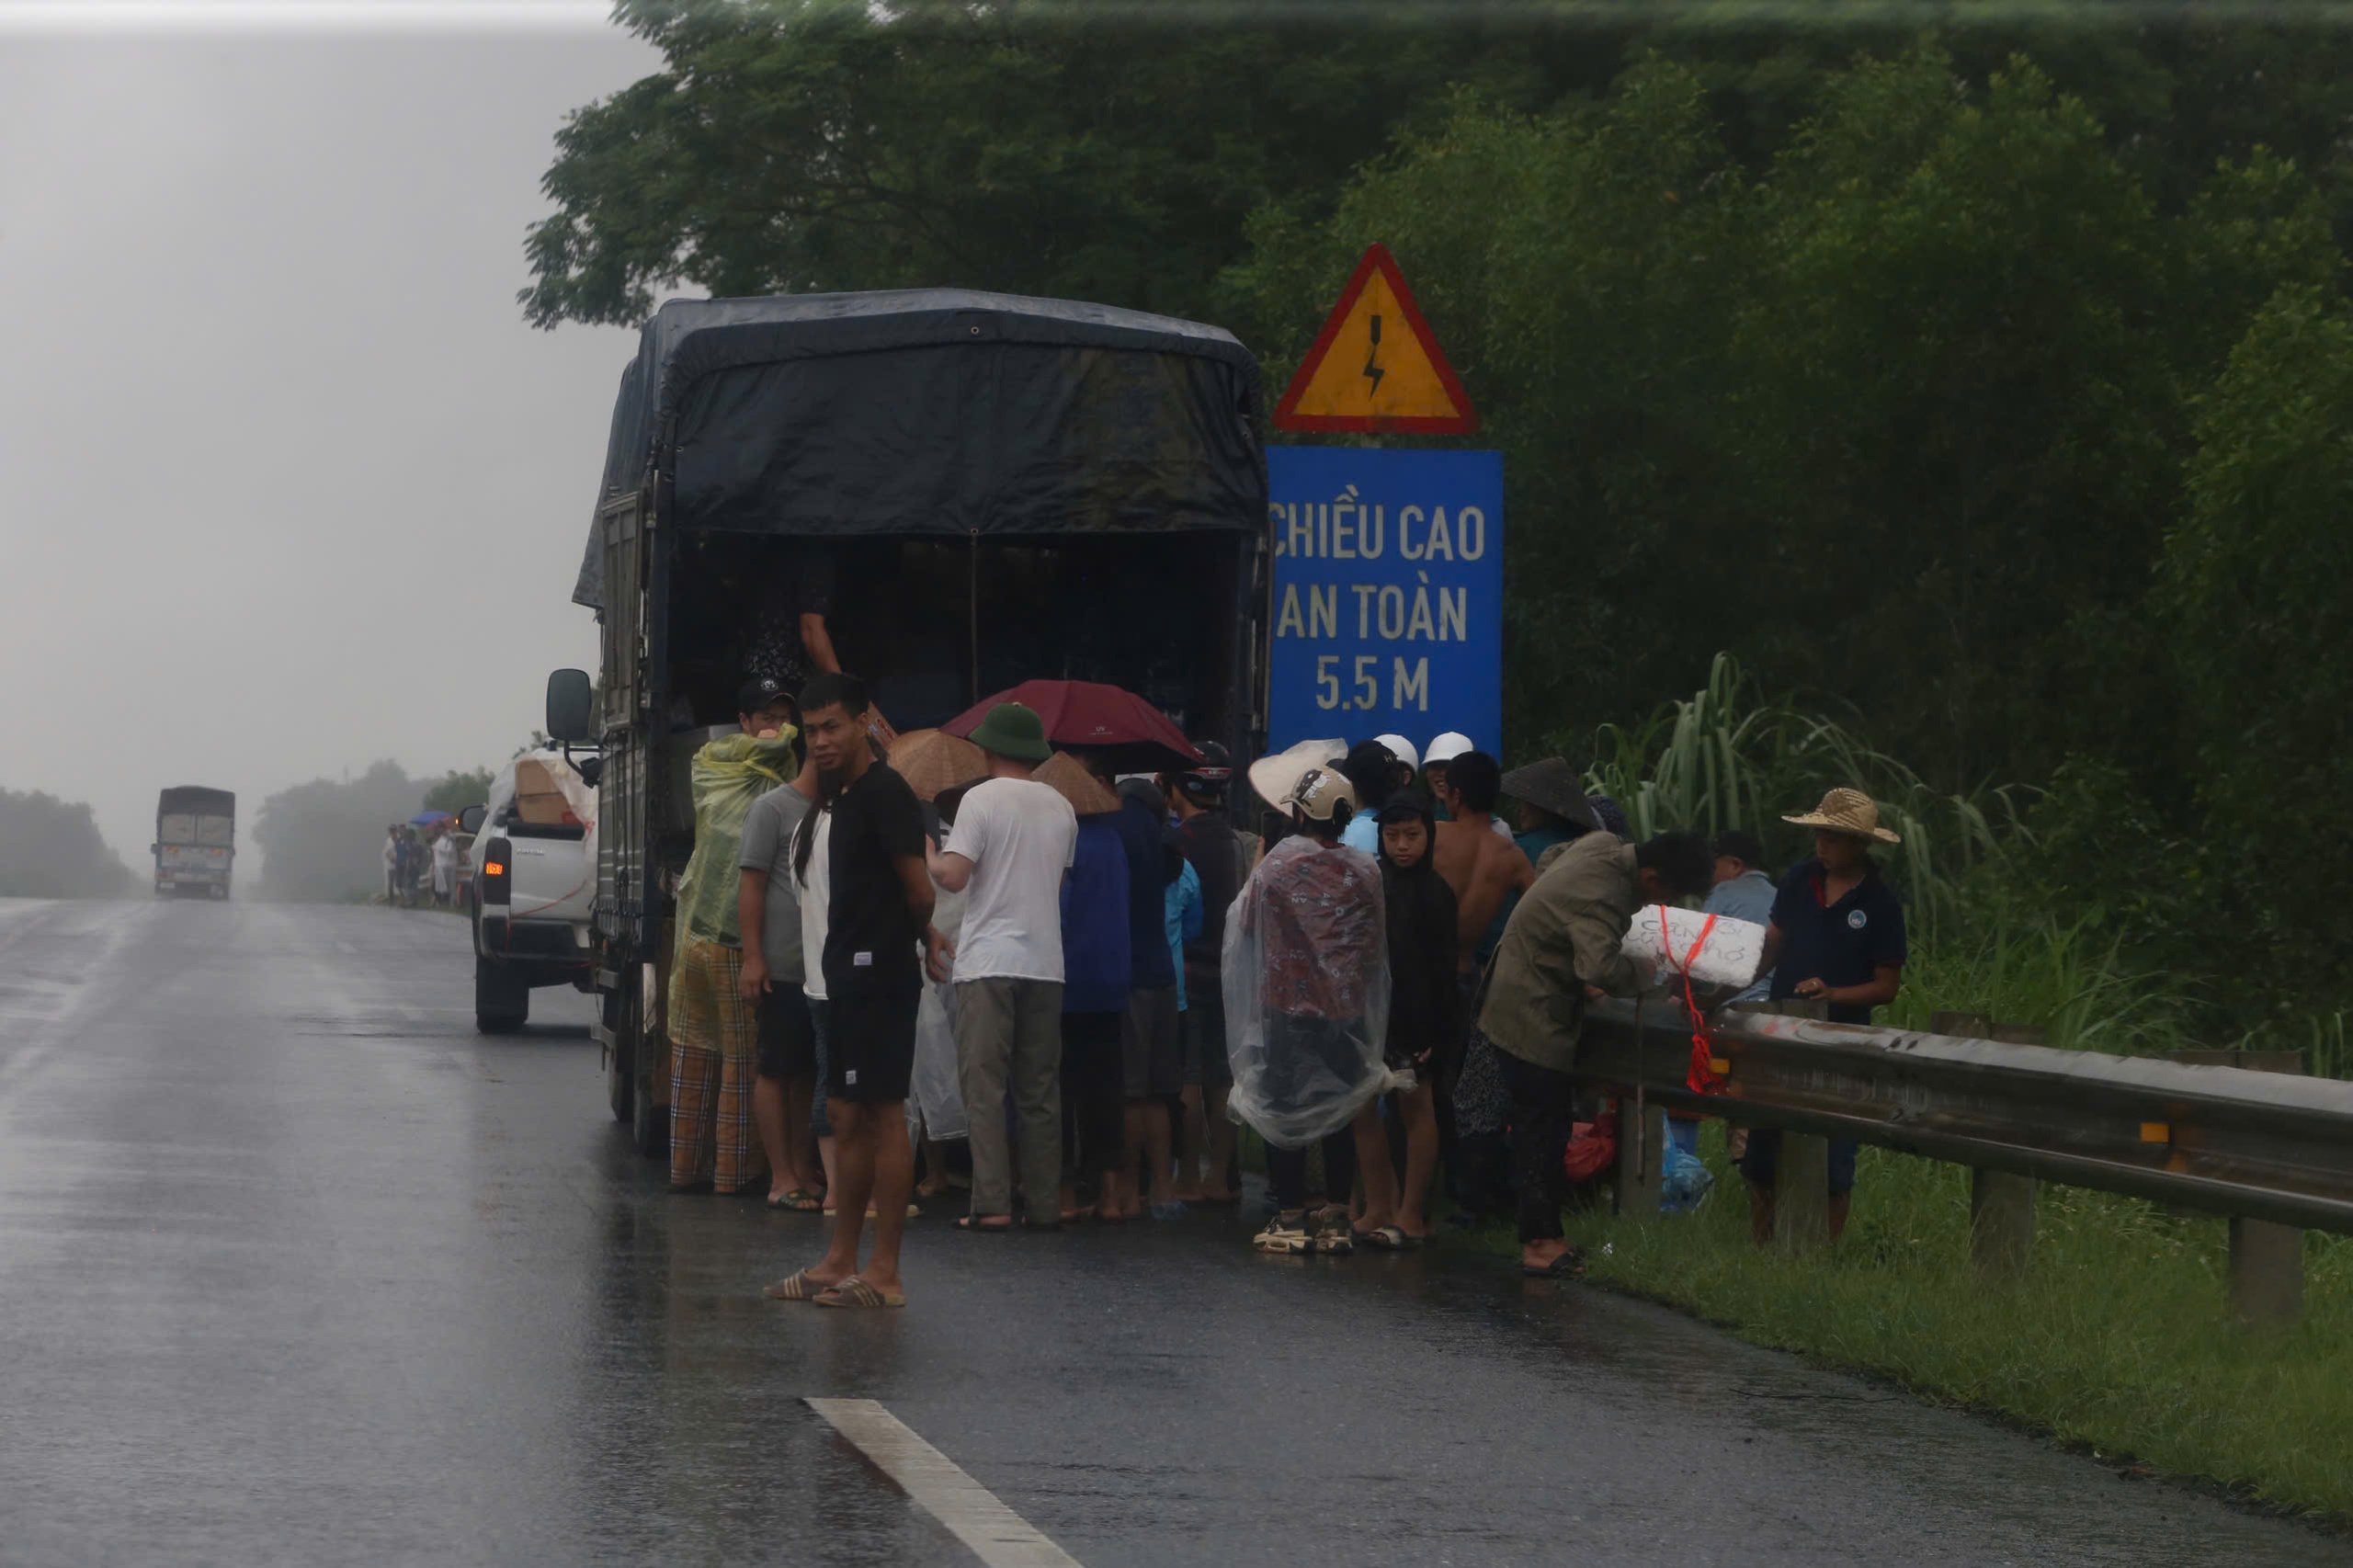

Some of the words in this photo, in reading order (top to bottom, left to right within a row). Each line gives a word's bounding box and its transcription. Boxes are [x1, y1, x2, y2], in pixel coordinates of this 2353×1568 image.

[1400, 504, 1484, 561] CAO
[1277, 583, 1336, 638] AN
[1352, 570, 1467, 642] TOÀN
[1316, 654, 1377, 710] 5.5
[1393, 656, 1428, 711] M
